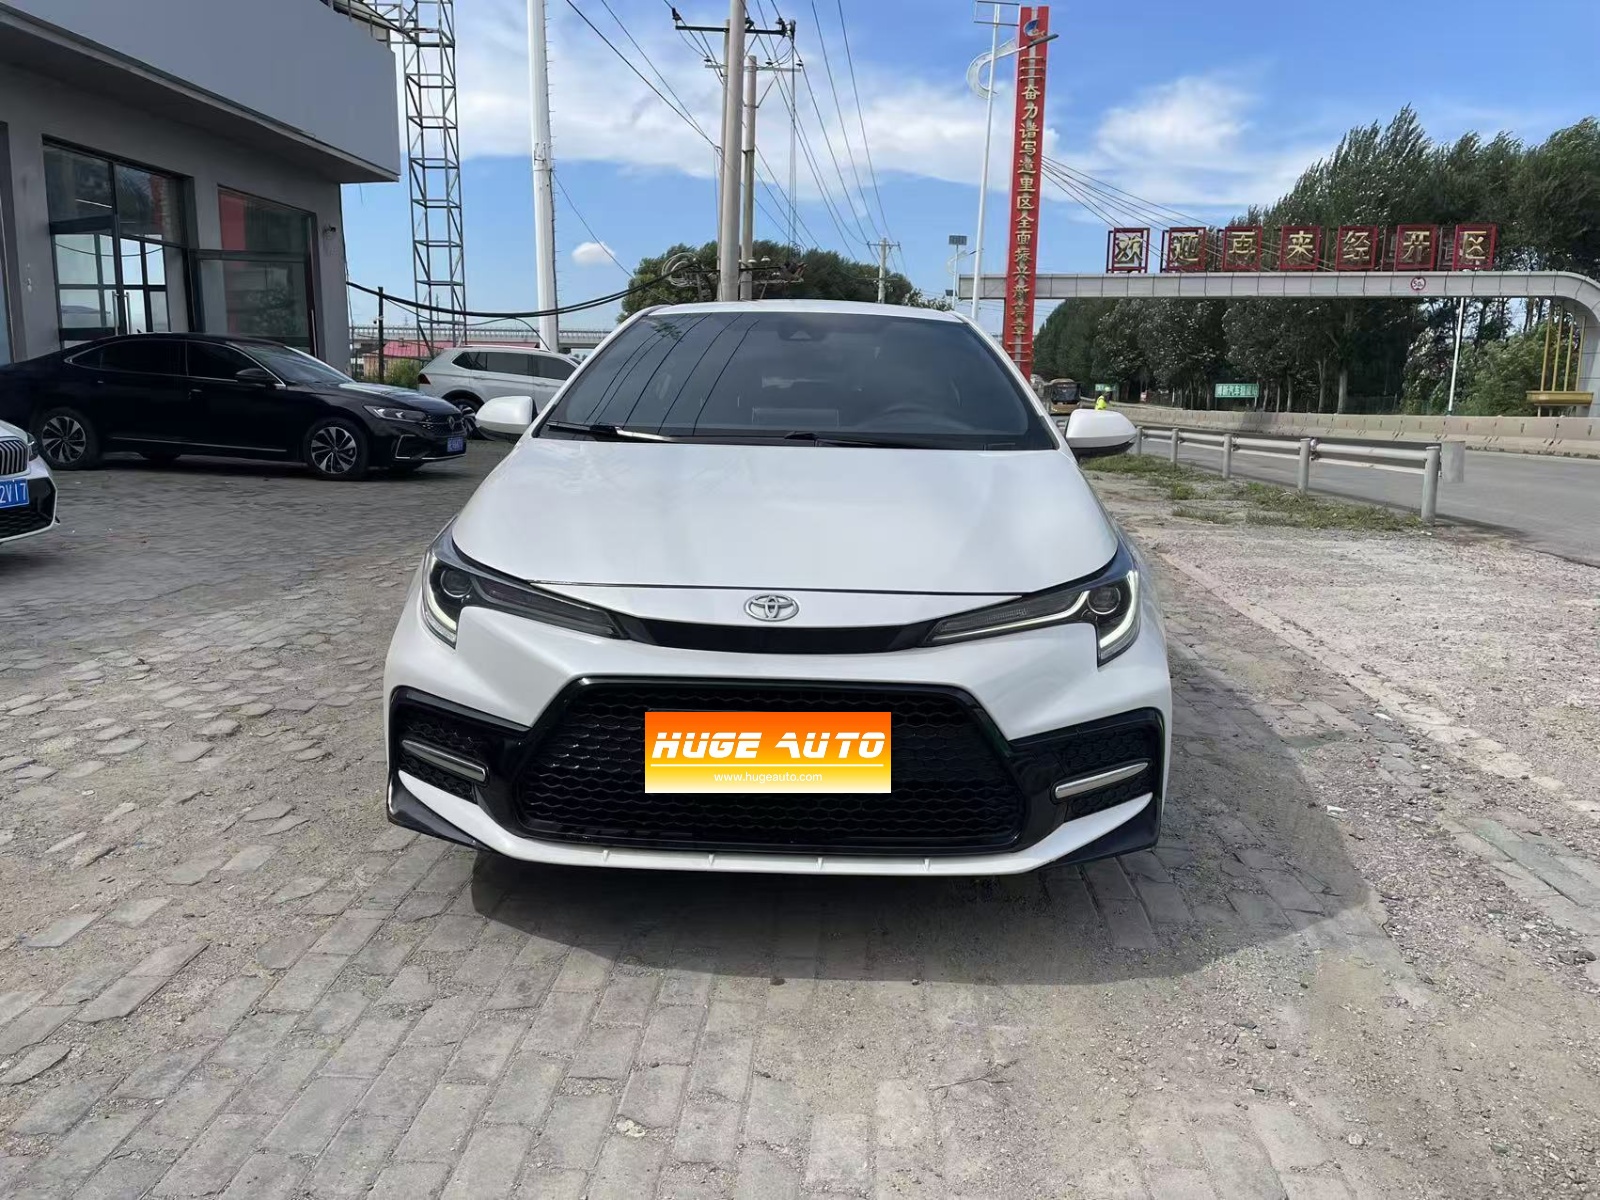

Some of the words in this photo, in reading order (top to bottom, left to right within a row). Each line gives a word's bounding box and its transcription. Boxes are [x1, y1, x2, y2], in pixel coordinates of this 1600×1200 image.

[1115, 229, 1489, 263] 欢迎再来经开区
